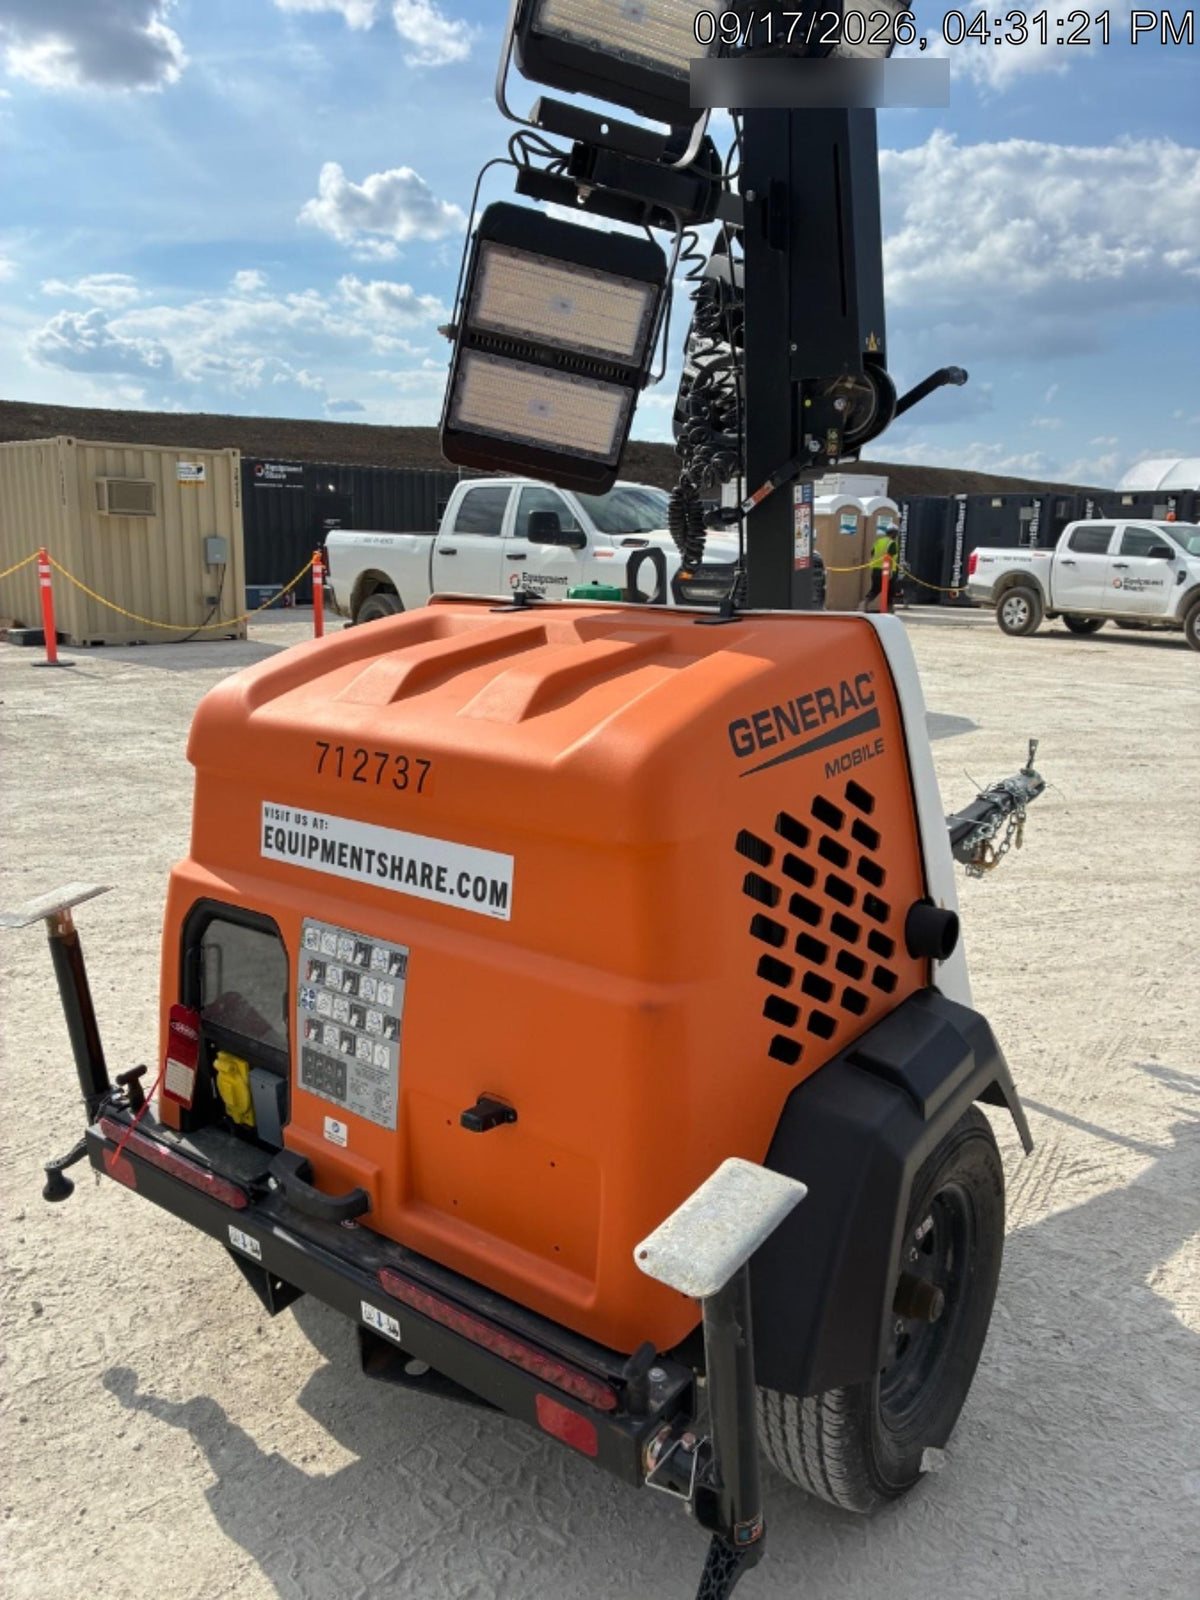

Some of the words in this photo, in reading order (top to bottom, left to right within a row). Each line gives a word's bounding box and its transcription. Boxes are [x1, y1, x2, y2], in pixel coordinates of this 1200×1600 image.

[728, 673, 876, 758] GENERAC
[315, 740, 432, 794] 712737
[824, 738, 885, 779] MOBILE
[264, 806, 290, 823] VISIT
[294, 810, 309, 826] US
[312, 815, 329, 830] AT:
[263, 825, 508, 909] EQUIPMENTSHARE.COM
